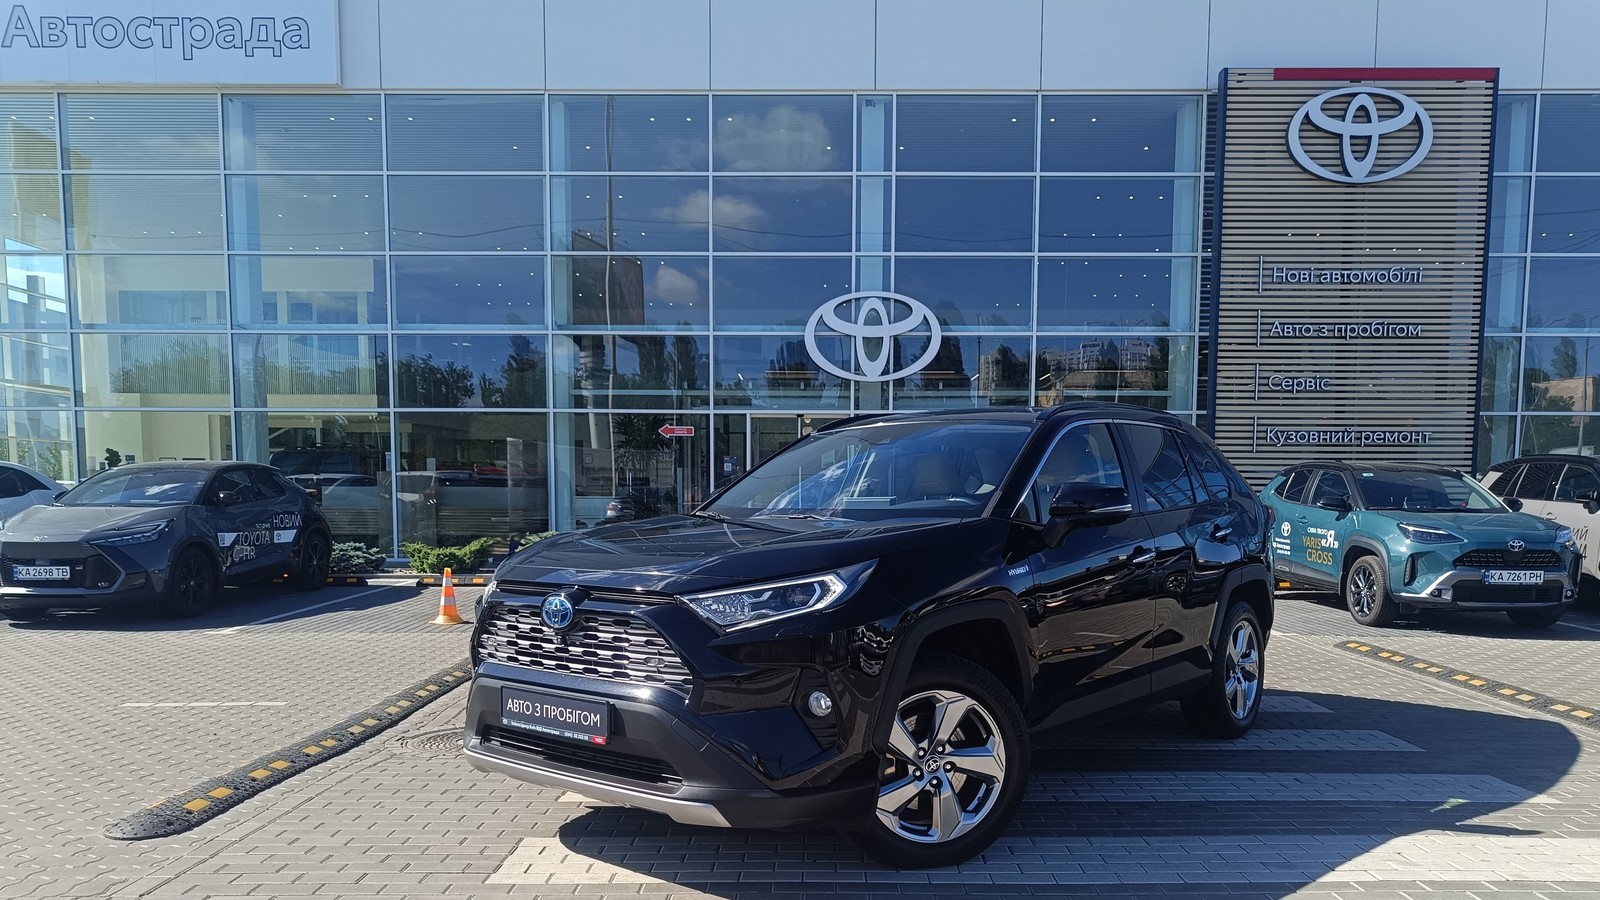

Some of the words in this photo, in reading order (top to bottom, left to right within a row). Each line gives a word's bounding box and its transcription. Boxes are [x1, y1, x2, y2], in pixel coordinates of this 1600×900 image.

[1, 4, 311, 61] Автострада
[1272, 266, 1315, 284] Нові
[1320, 266, 1424, 284] автомобілі
[1269, 320, 1314, 338] Авто
[1318, 323, 1328, 338] з
[1334, 320, 1422, 342] пробігом
[1268, 375, 1332, 395] Сервіс
[1266, 426, 1356, 447] Кузовний
[1361, 430, 1433, 448] ремонт
[272, 512, 303, 528] НОВИЙ
[237, 531, 271, 546] TOYOTA
[1302, 535, 1322, 549] YARIS
[233, 545, 256, 561] C-HR
[1306, 549, 1333, 566] CROSS
[18, 567, 32, 577] KA
[32, 567, 54, 577] 2698
[55, 567, 69, 577] TB
[1490, 572, 1504, 582] KA
[1506, 572, 1527, 582] 7261
[1529, 572, 1542, 582] PH
[506, 698, 533, 715] АВТО
[543, 704, 601, 728] ПРОБІГОМ
